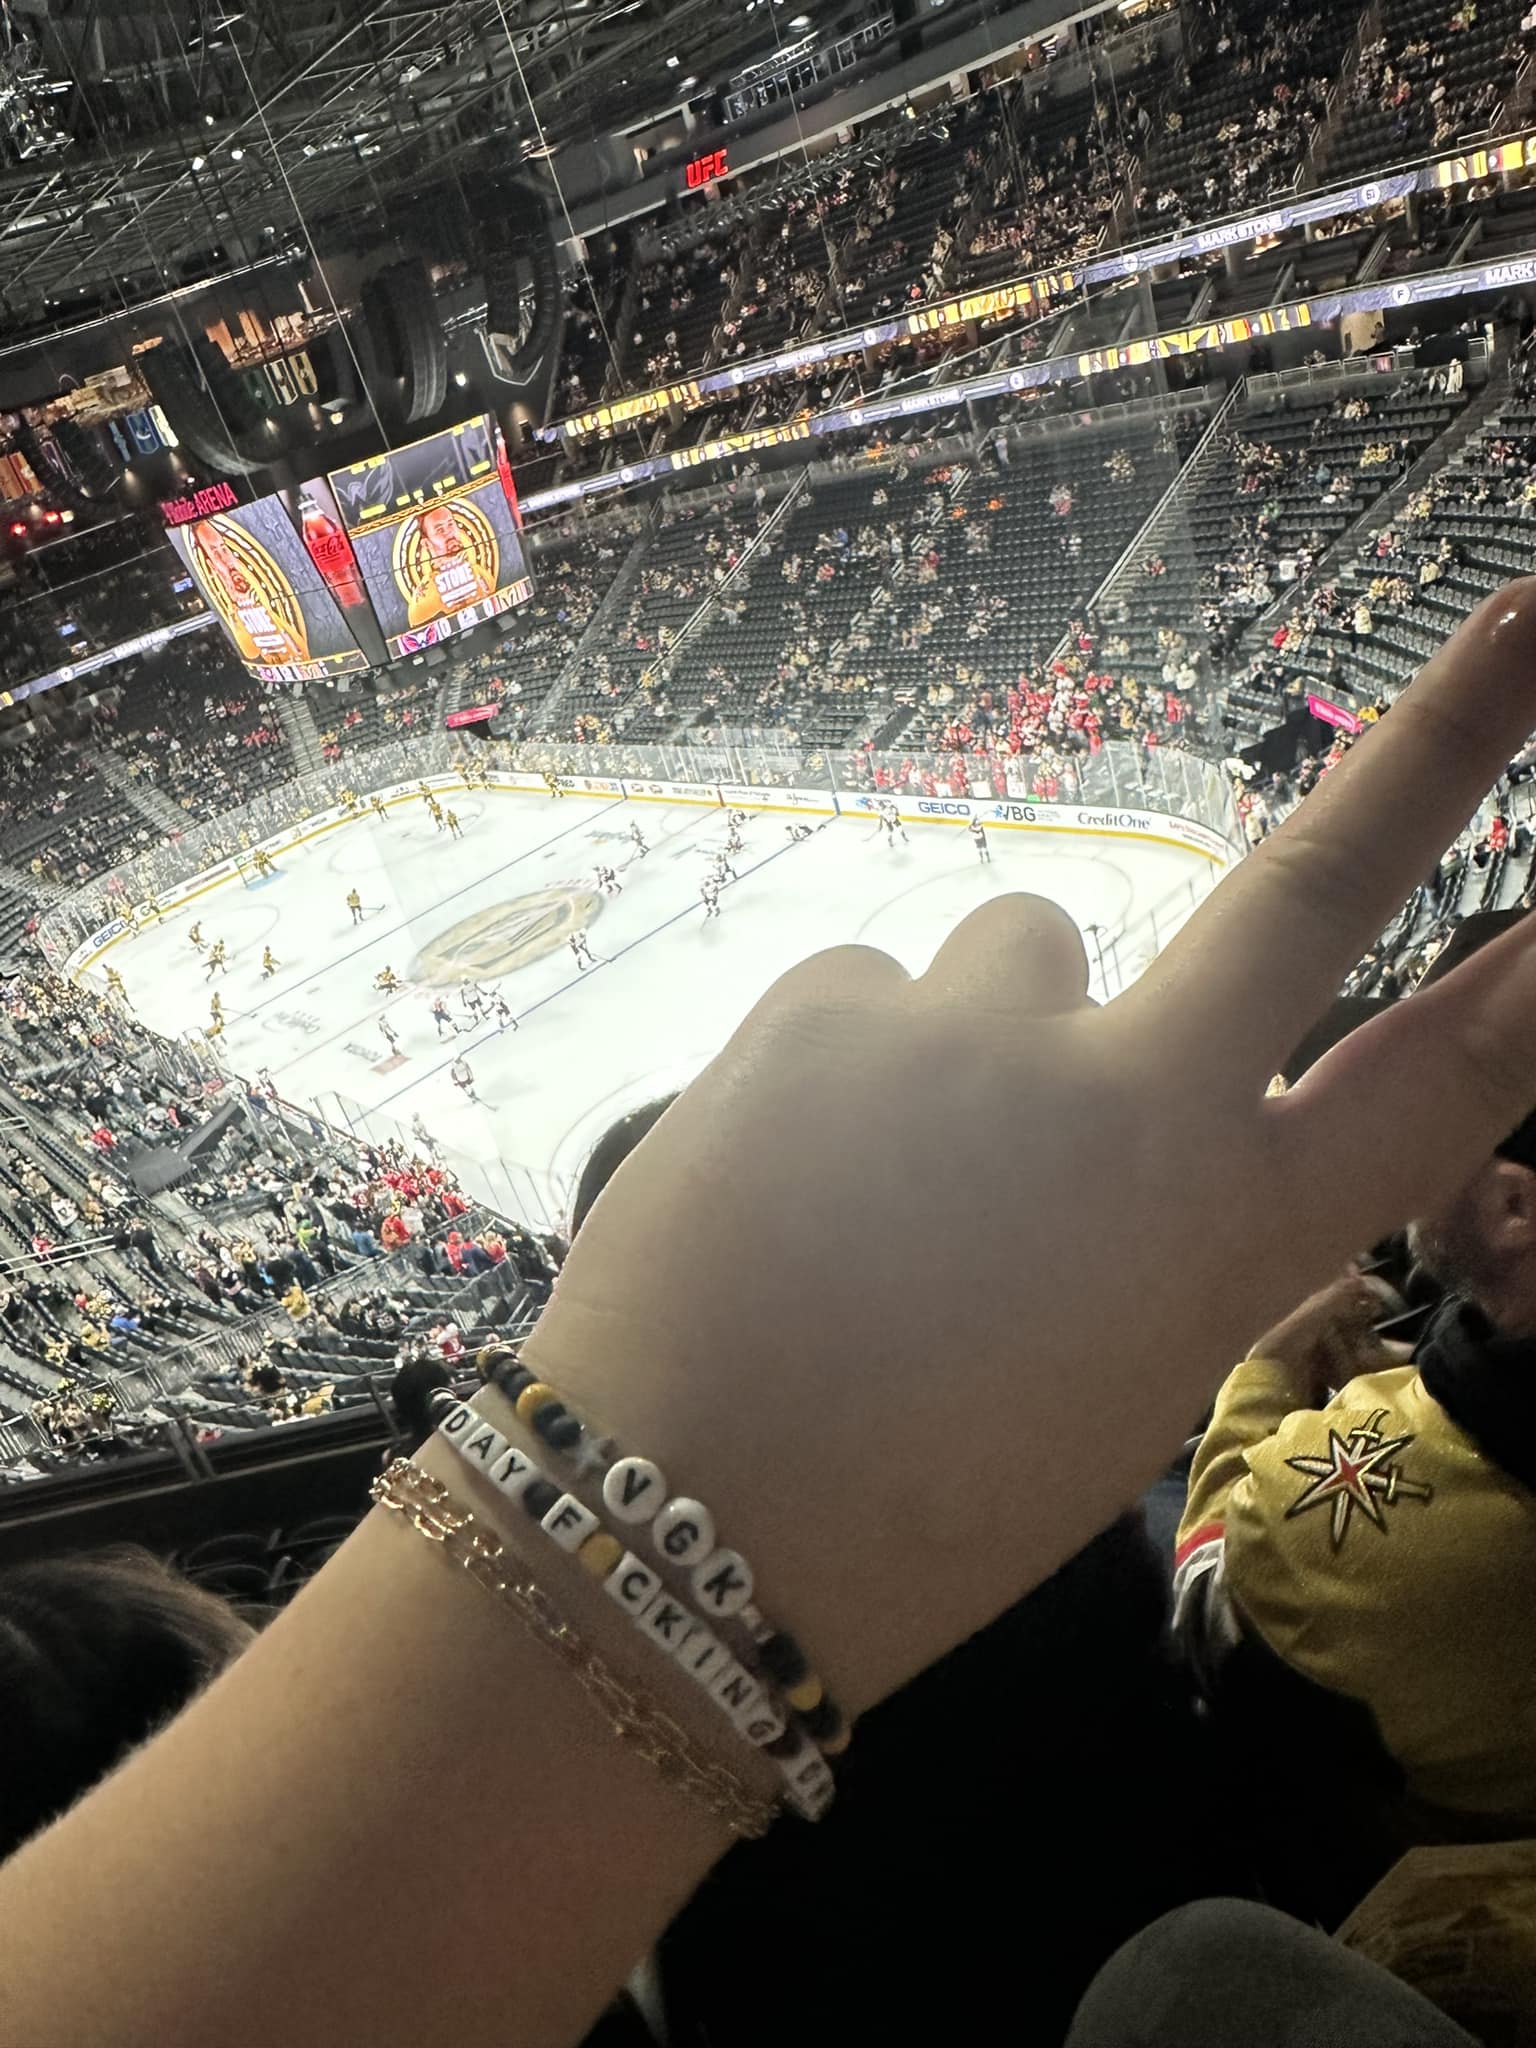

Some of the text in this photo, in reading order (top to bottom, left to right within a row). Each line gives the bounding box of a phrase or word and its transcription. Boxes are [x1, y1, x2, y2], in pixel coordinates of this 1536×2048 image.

[686, 149, 729, 189] UFC
[1485, 261, 1534, 284] MARK
[193, 482, 238, 516] ARENA
[918, 801, 971, 816] GEICO
[445, 1409, 526, 1482] DAY
[622, 1467, 746, 1606] VGK
